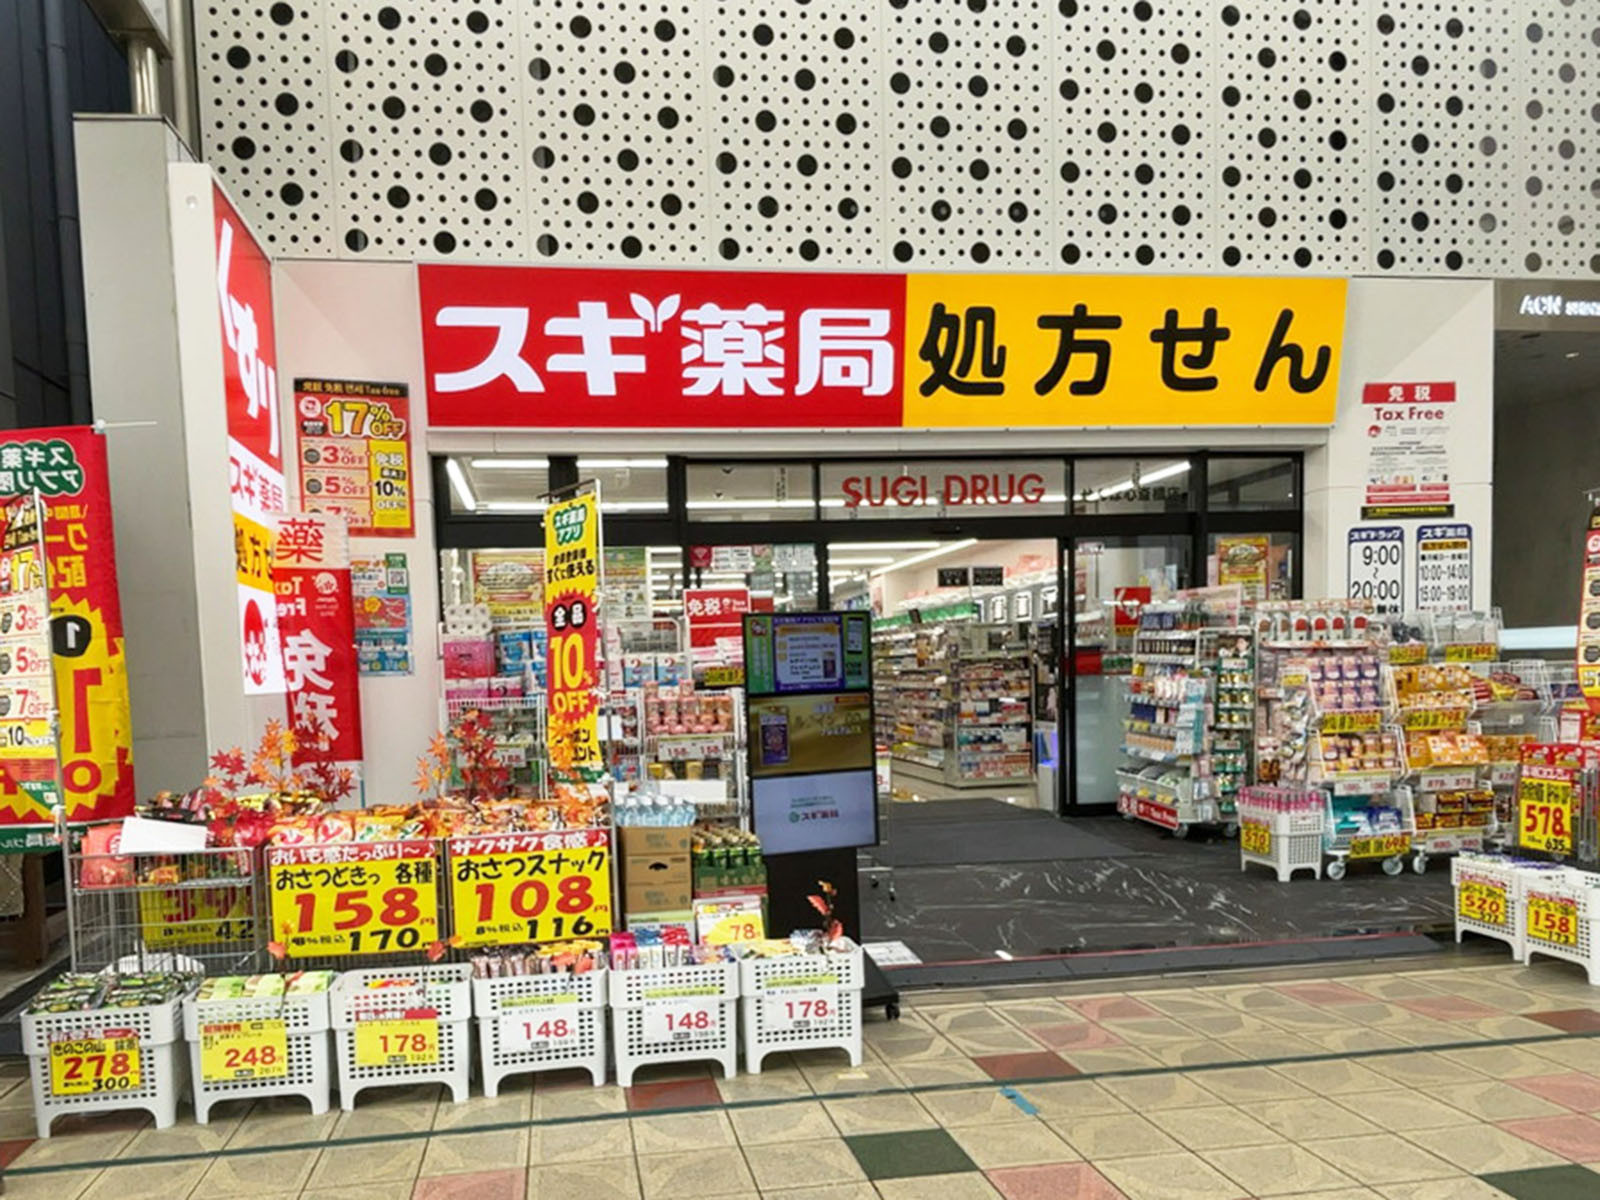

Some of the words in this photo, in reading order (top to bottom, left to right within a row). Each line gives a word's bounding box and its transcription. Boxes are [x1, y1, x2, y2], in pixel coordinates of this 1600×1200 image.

[217, 218, 280, 459] くすり
[433, 294, 896, 396] スギ薬局
[919, 302, 1331, 397] 処方せん
[327, 401, 391, 435] 17%
[371, 421, 403, 437] OFF
[1374, 406, 1404, 421] Tax
[1409, 406, 1444, 420] Free
[842, 476, 927, 508] SUGI
[944, 473, 1045, 505] DRUG
[1363, 545, 1400, 565] 9:00
[1352, 580, 1400, 600] 20:00
[553, 690, 589, 714] OFF
[1525, 804, 1564, 837] 578
[276, 867, 380, 890] おさつどきっ
[395, 861, 432, 884] 各種
[457, 850, 605, 881] おさつスナック
[1533, 910, 1570, 933] 158
